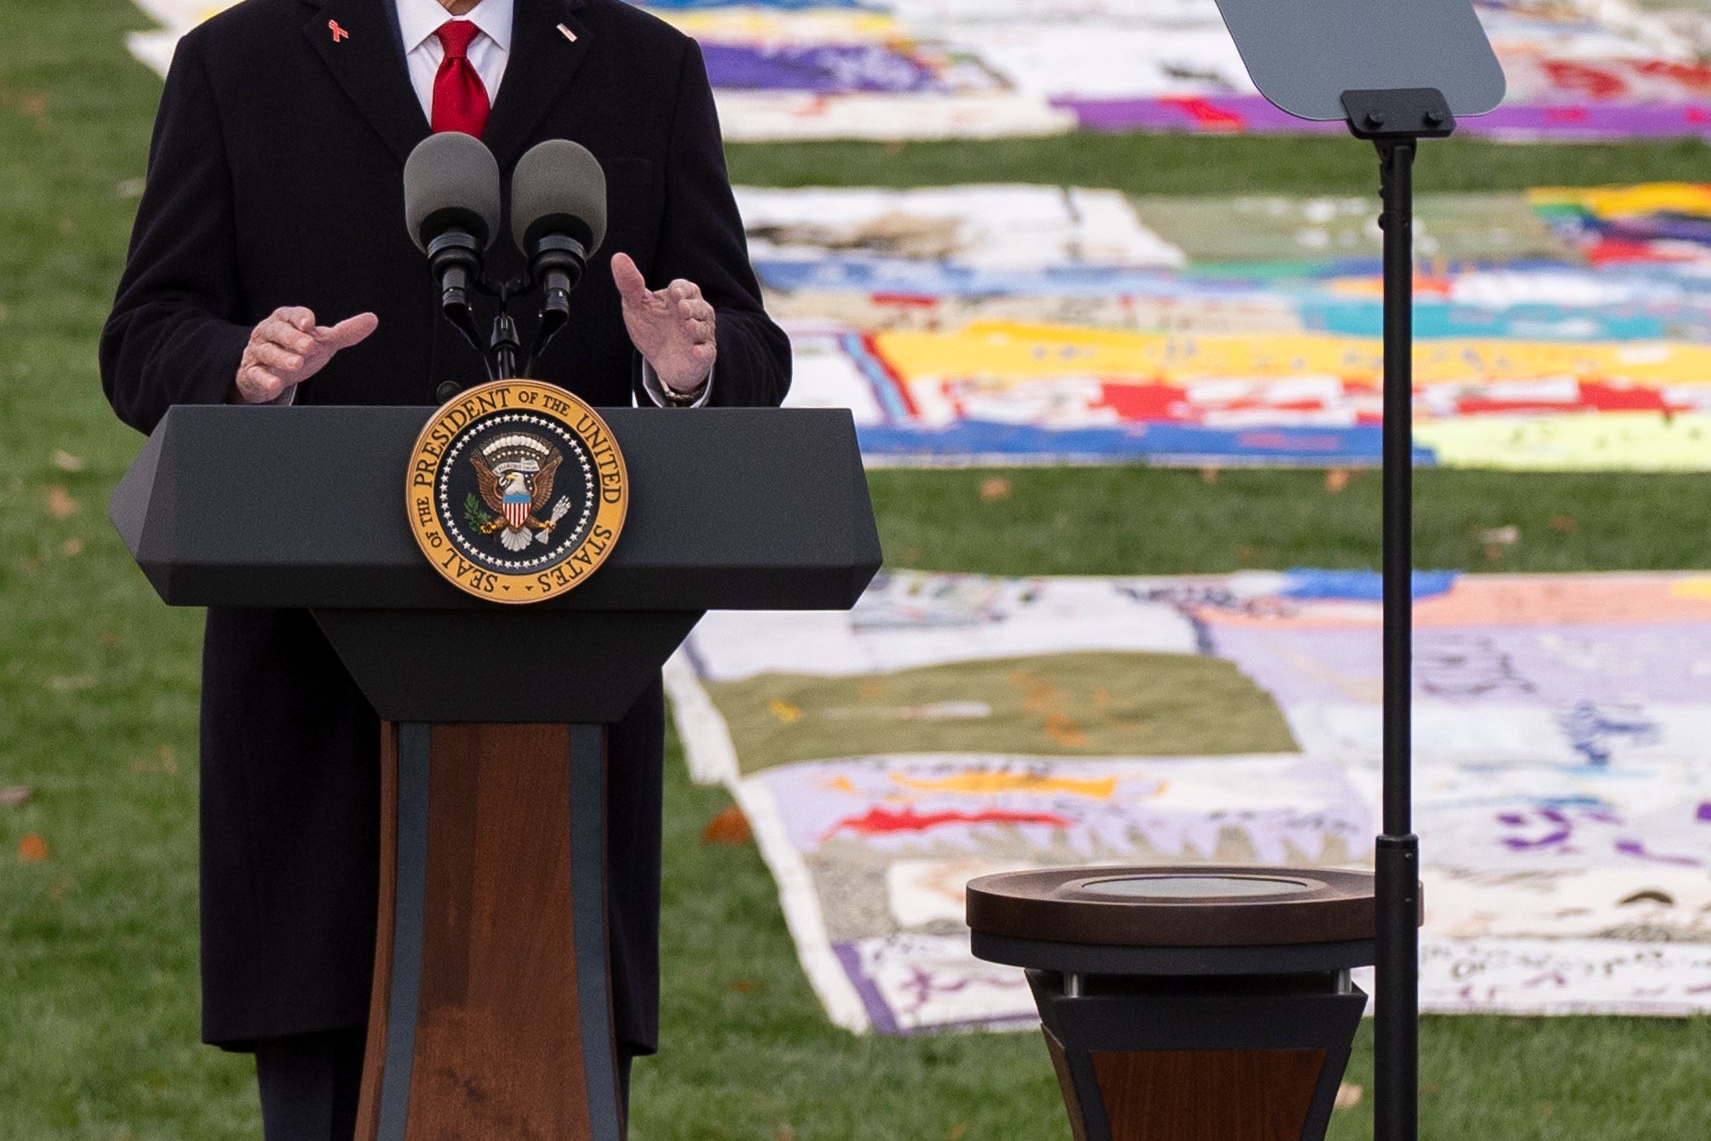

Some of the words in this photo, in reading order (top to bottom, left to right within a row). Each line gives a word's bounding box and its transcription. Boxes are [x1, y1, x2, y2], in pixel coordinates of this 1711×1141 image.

[518, 391, 539, 405] OF
[543, 394, 571, 416] THE
[414, 388, 511, 488] PRESIDENT
[575, 414, 622, 504] UNITED
[416, 496, 432, 528] THE
[425, 530, 443, 548] OF
[537, 523, 613, 593] STATES
[441, 547, 499, 593] SEAL
